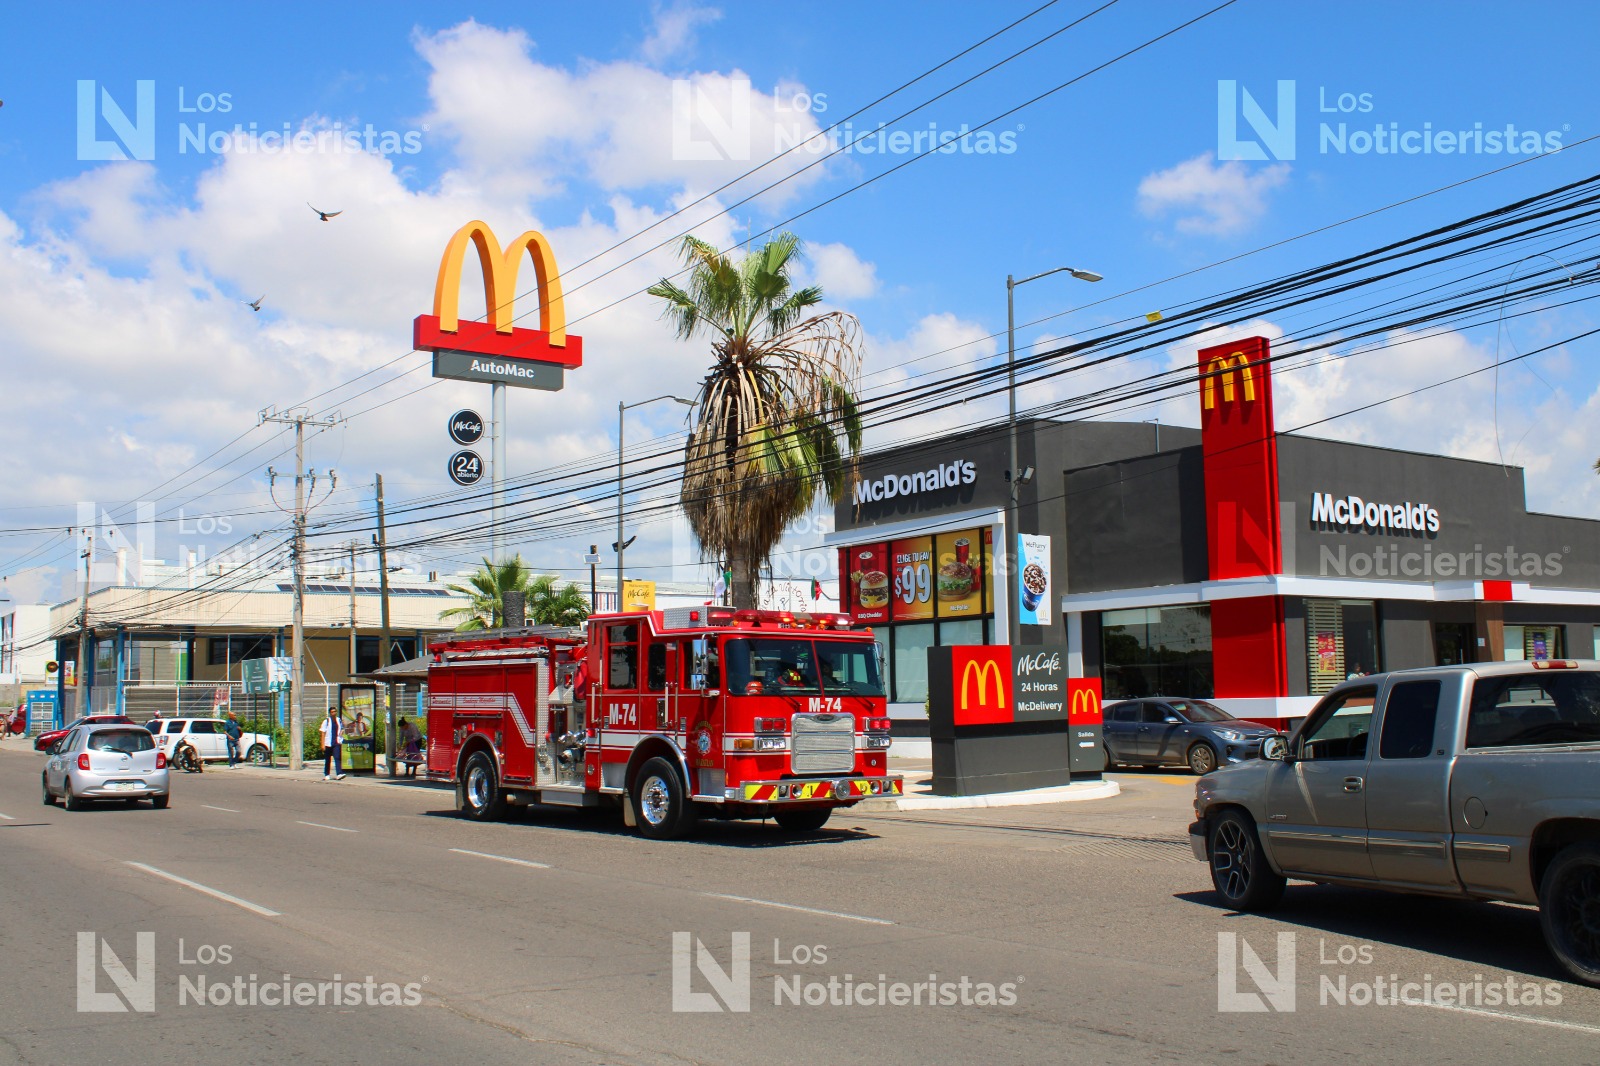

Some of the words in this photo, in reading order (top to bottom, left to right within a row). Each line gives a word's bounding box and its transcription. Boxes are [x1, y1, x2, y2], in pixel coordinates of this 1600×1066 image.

[470, 359, 535, 378] AutoMac
[457, 456, 479, 472] 24
[852, 459, 977, 505] McDonald's
[1311, 491, 1440, 532] McDonald's
[897, 553, 911, 564] ELIGE
[912, 553, 919, 562] TU
[920, 551, 930, 561] FAV
[1017, 652, 1060, 677] McCafé
[1021, 683, 1031, 692] 24
[1033, 682, 1058, 692] Horas
[808, 697, 842, 713] M-74
[1017, 701, 1062, 712] McDelivery
[609, 703, 637, 726] M-74
